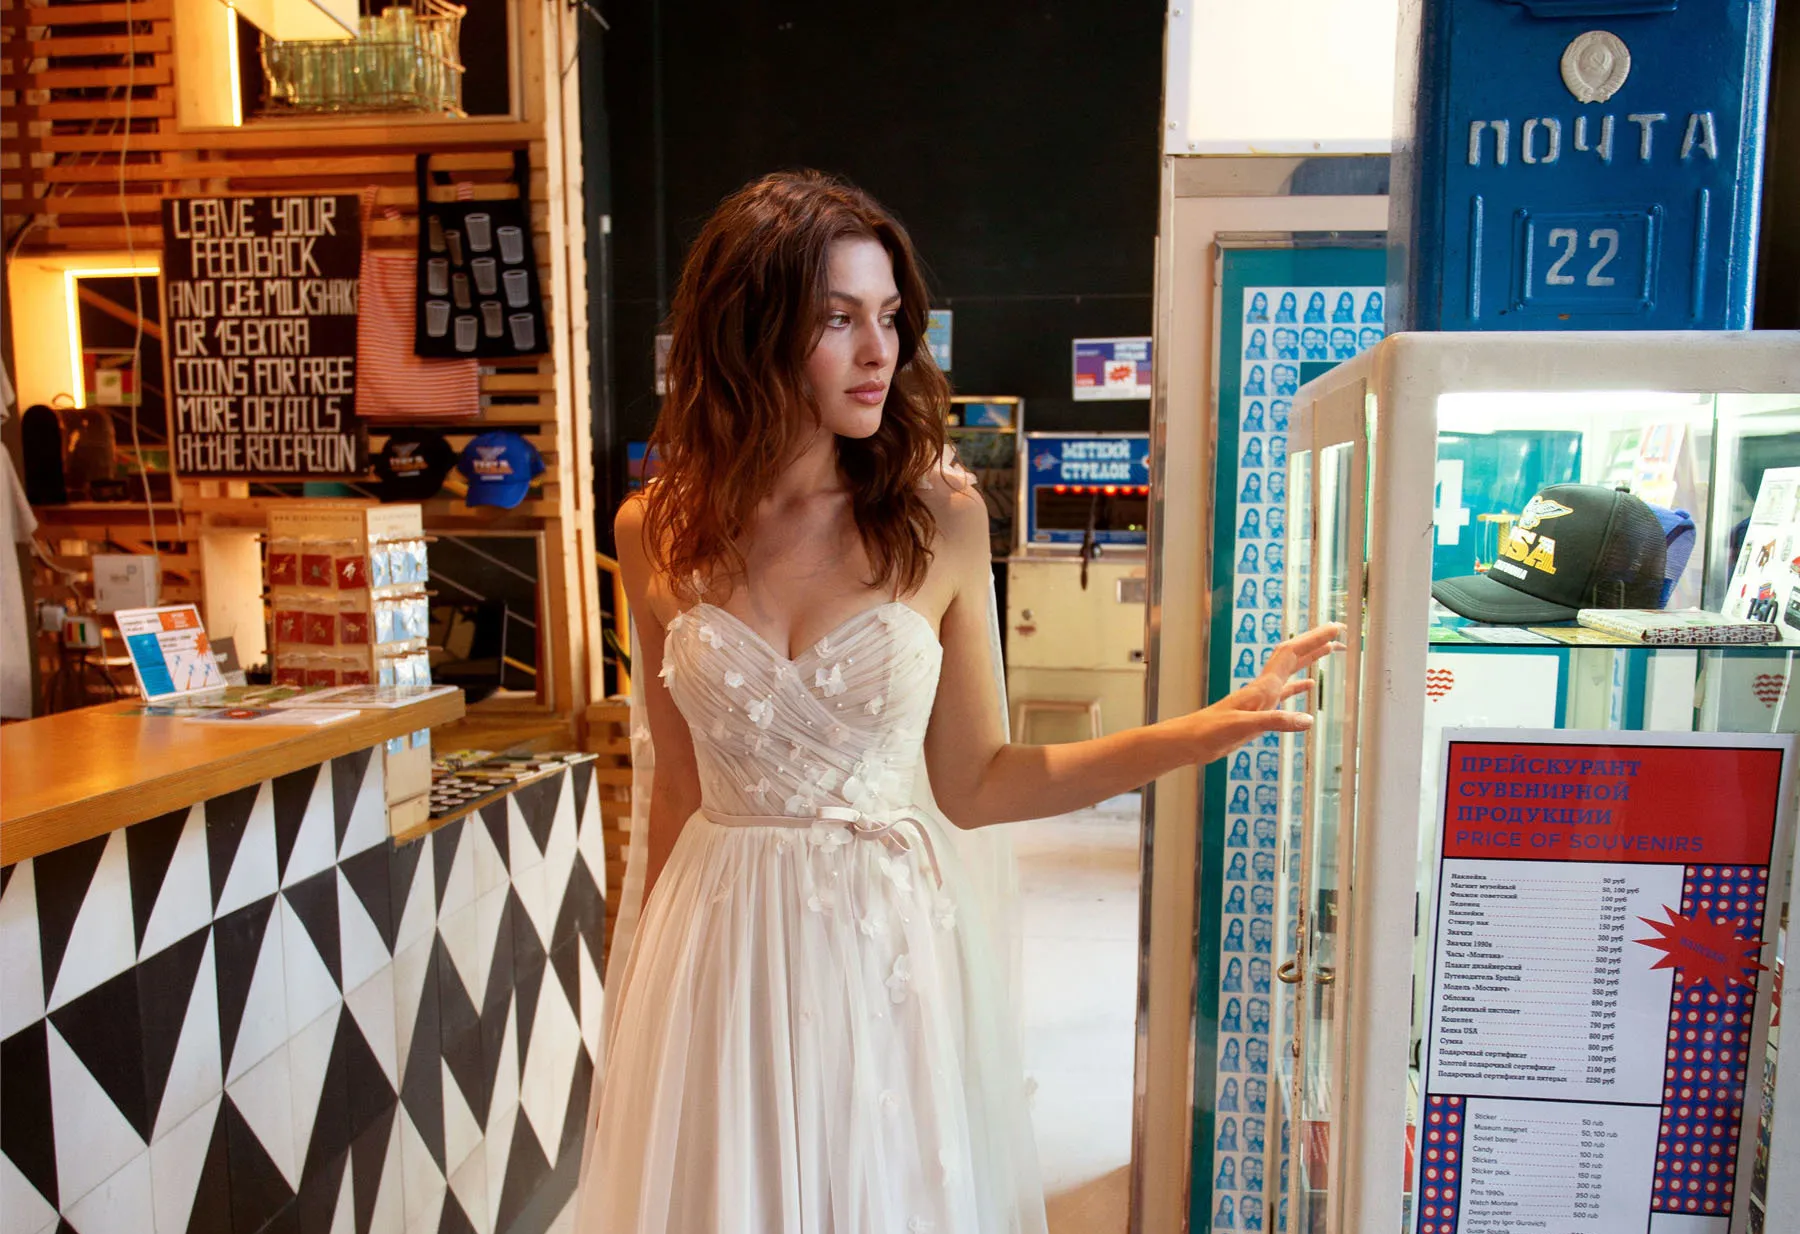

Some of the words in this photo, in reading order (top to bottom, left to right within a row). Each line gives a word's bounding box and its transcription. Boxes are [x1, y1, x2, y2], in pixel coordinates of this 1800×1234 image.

[1468, 111, 1717, 166] ПОЧТА
[173, 199, 254, 238] LEAVE
[272, 197, 336, 236] YOUR
[191, 236, 321, 278] FEEDBACK
[1545, 228, 1619, 287] 22
[169, 279, 215, 318] AND
[175, 319, 208, 356] OR
[215, 319, 240, 355] 15
[243, 318, 310, 355] EXTRA
[174, 358, 249, 395] COINS
[255, 358, 296, 394] FOR
[300, 357, 353, 394] FREE
[178, 397, 239, 433] MORE
[243, 397, 341, 432] DETAILS
[1461, 754, 1641, 777] ПРЕЙСКУРАНТ
[1459, 780, 1630, 800] СУВЕНИРНОЙ
[1457, 806, 1612, 826] ПРОДУКЦИИ
[1456, 830, 1521, 847] PRICE
[1530, 833, 1561, 848] OF
[1569, 834, 1703, 852] SOUVENIRS
